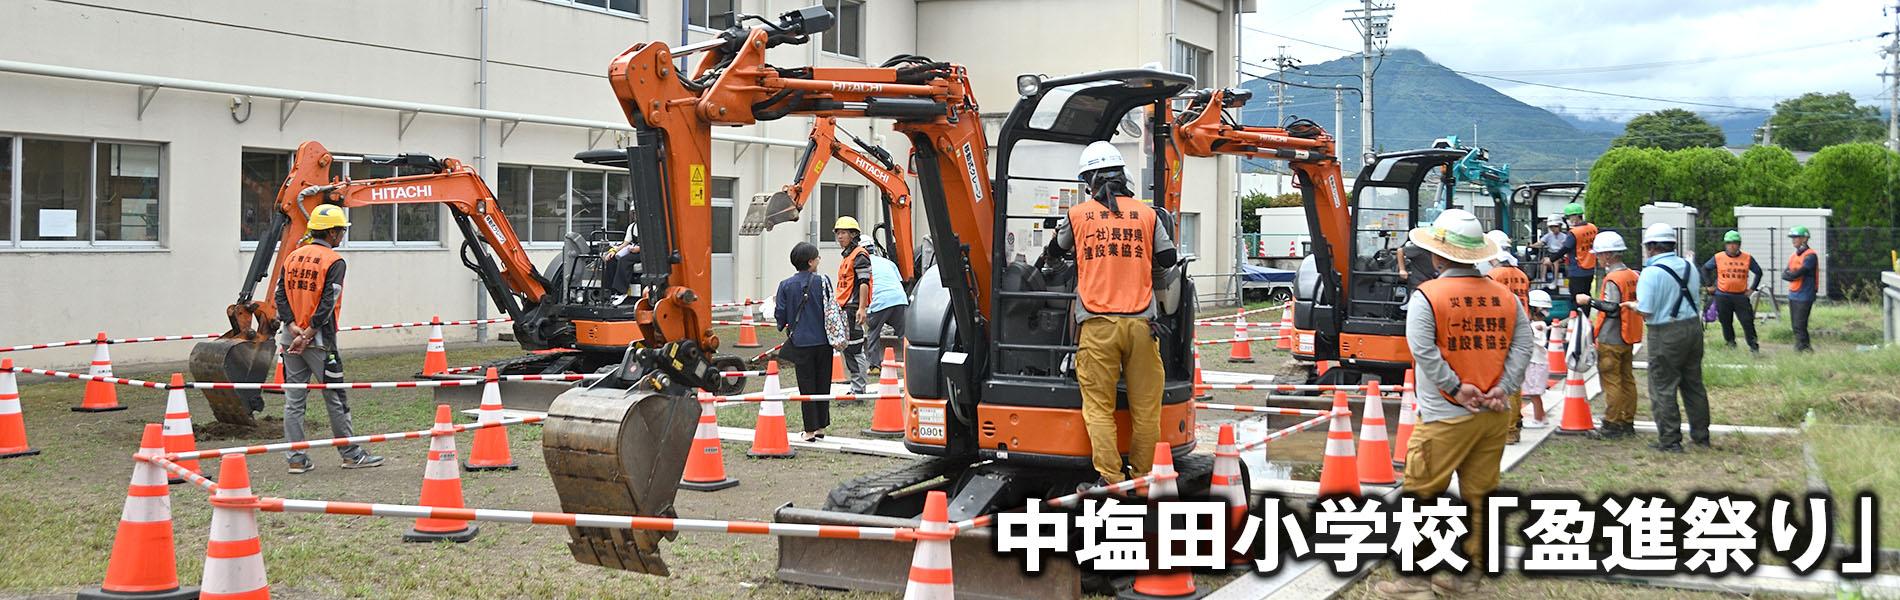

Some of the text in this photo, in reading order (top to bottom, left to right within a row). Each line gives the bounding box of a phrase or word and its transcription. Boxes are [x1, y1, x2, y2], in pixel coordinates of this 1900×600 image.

[832, 81, 883, 93] HITACHI
[855, 156, 890, 183] HITACHI
[371, 184, 432, 200] HITACHI
[1085, 210, 1139, 222] 災害支援
[1083, 243, 1144, 260] 建設業協会
[1449, 296, 1502, 308] 災害支援
[1447, 335, 1507, 351] 建設業協会
